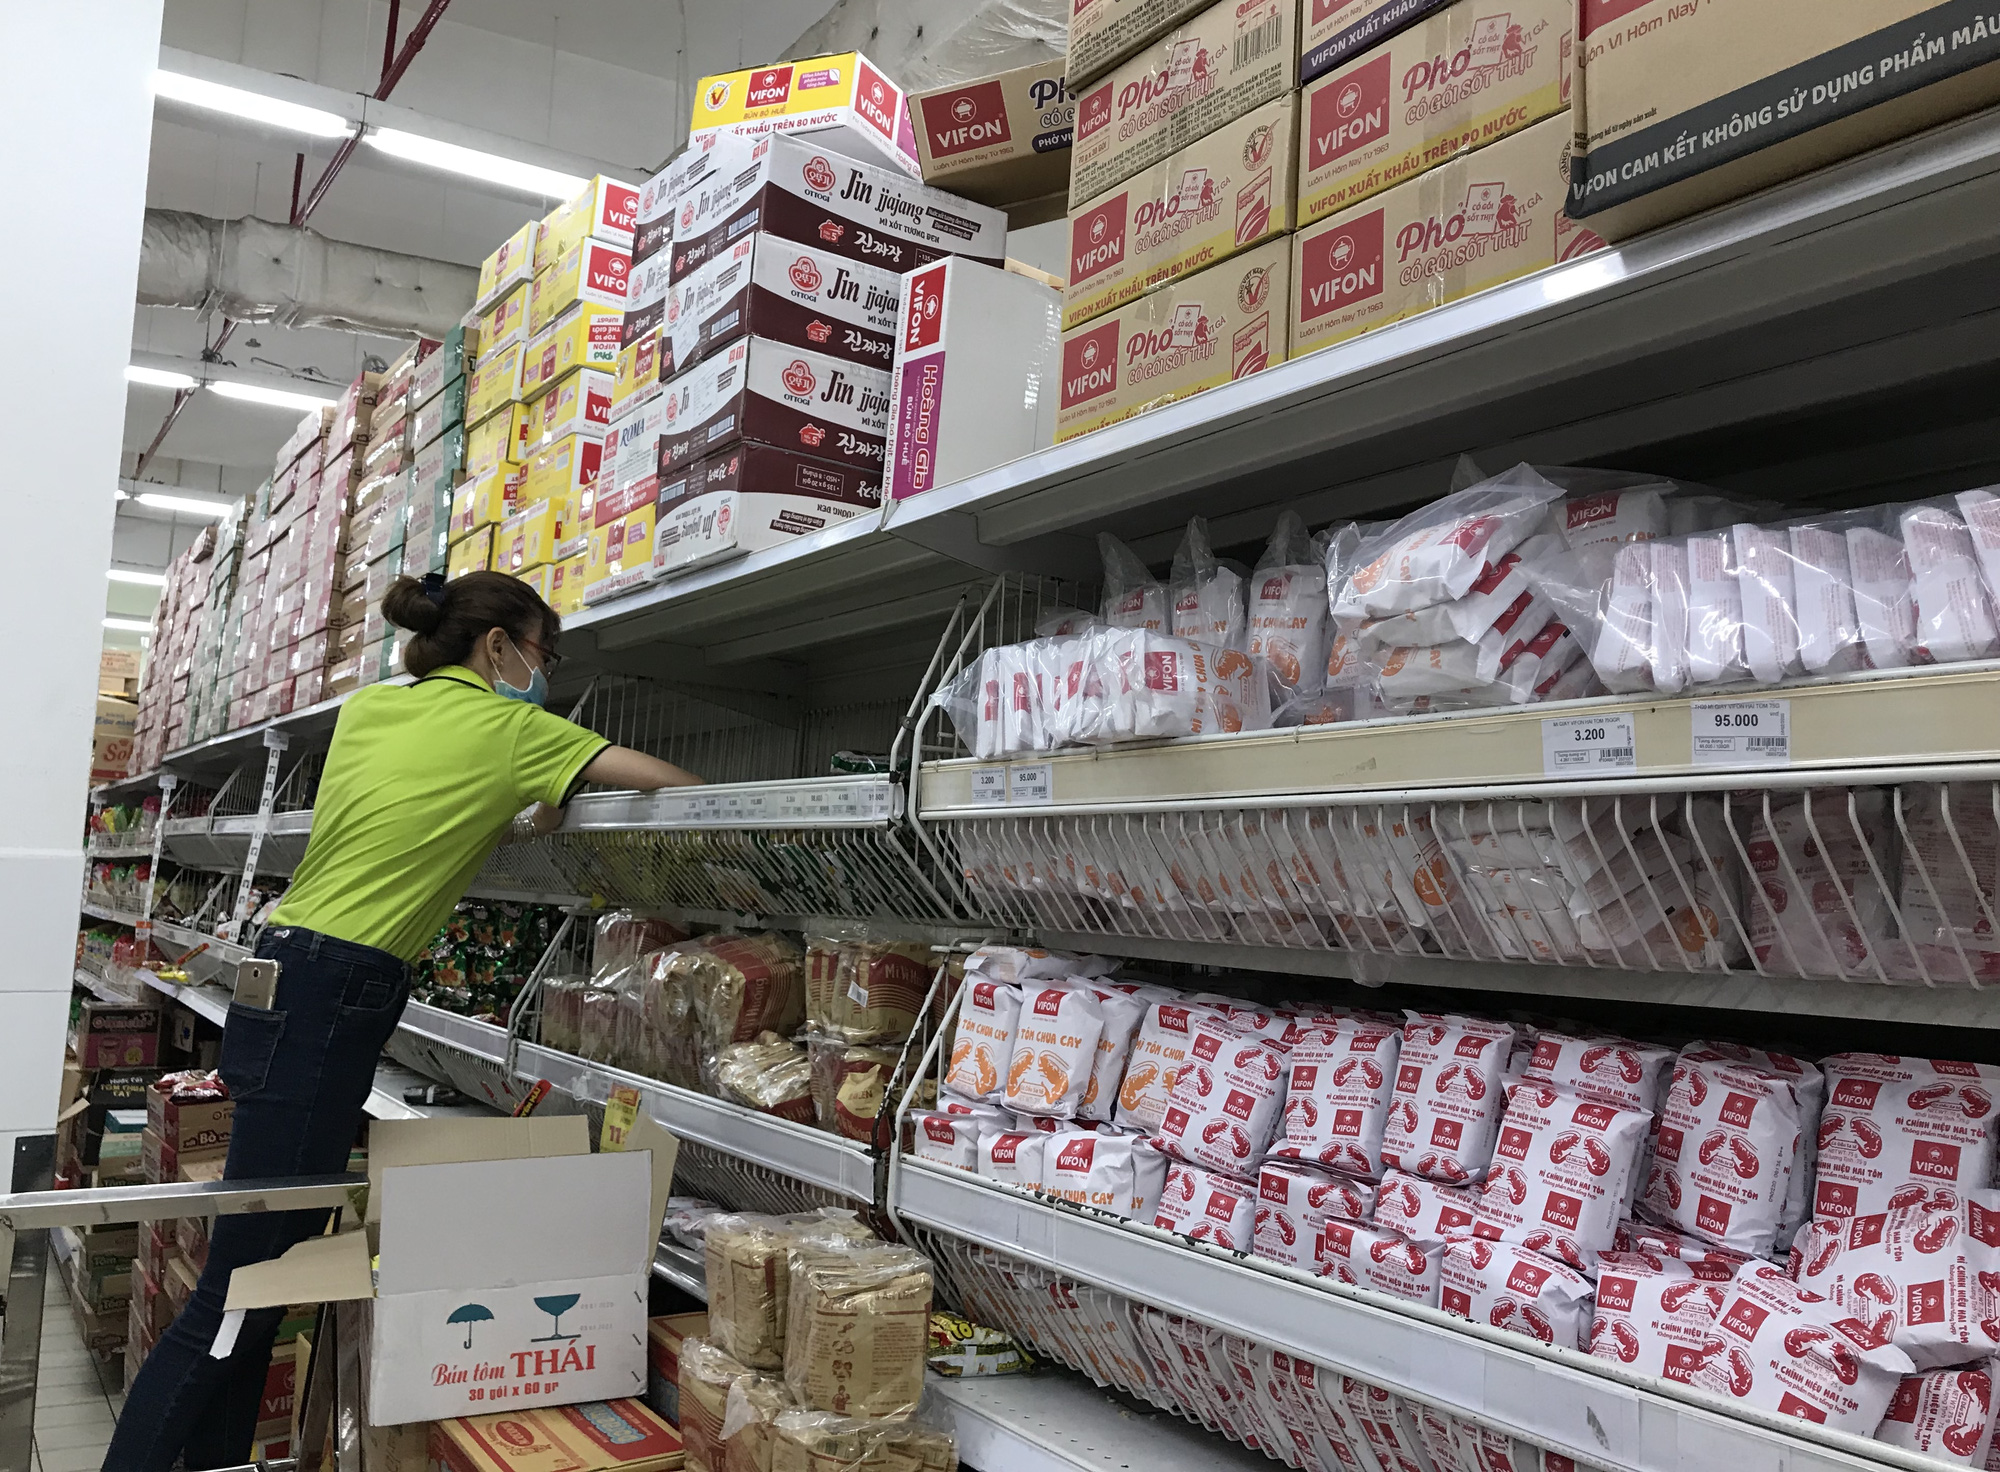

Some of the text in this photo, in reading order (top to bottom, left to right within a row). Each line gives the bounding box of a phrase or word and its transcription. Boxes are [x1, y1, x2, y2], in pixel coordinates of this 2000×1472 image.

[744, 104, 786, 120] BÚN BÒ HUẾ
[1621, 150, 1660, 182] CAM
[1663, 130, 1698, 170] KẾT
[1702, 105, 1772, 150] KHÔNG
[1776, 89, 1809, 118] SỬ
[1812, 63, 1874, 106] DỤNG
[1880, 32, 1946, 78] PHẨM
[744, 120, 770, 136] KHẨU
[772, 118, 795, 131] TRÊN
[810, 113, 838, 125] NƯỚC
[1081, 110, 1109, 134] VIFON
[936, 118, 1002, 149] VIFON
[1316, 108, 1382, 156] VIFON
[933, 160, 950, 172] Luôn
[958, 155, 974, 165] Hôm
[975, 154, 988, 164] Nay
[999, 147, 1014, 156] 1963
[1310, 191, 1346, 215] VIFON
[1348, 168, 1382, 198] XUẤT
[1384, 150, 1420, 182] KHẨU
[1423, 138, 1460, 164] TRÊN
[1482, 106, 1528, 141] NƯỚC
[804, 188, 830, 202] OTTOGI
[840, 168, 925, 225] Jin jjajang
[880, 217, 888, 226] MÌ
[889, 219, 902, 230] XỐT
[904, 226, 926, 240] TƯƠNG
[1396, 202, 1467, 263] Phở
[1076, 237, 1120, 274] VIFON
[1400, 219, 1532, 286] CÓ GÓI SỐT THỊT
[827, 268, 860, 302] Jin
[1310, 264, 1376, 308] VIFON
[790, 290, 817, 302] OTTOGI
[1300, 324, 1316, 339] Luôn
[1324, 314, 1340, 328] Hôm
[1340, 310, 1356, 324] Nay
[1368, 301, 1384, 314] 1963
[608, 326, 621, 334] THẾ
[842, 330, 894, 360] 진짜장
[1127, 337, 1219, 386] CÓ GÓI SỐT THỊT
[820, 370, 855, 406] Jin
[1066, 364, 1112, 398] VIFON
[784, 393, 810, 406] OTTOGI
[620, 418, 645, 447] ROMA
[914, 364, 938, 488] Hoàng Gia
[1714, 714, 1759, 727] 95.000
[1574, 728, 1605, 741] 3.200
[980, 776, 994, 784] 3.200
[1020, 772, 1037, 782] 95.000
[974, 993, 993, 1008] VIFON
[1036, 1000, 1058, 1013] VIFON
[1160, 1014, 1186, 1028] VIFON
[1020, 1027, 1082, 1050] TÔM CHUA CAY
[1458, 1044, 1480, 1056] VIFON
[1838, 1092, 1872, 1106] VIFON
[1226, 1103, 1249, 1118] VIFON
[1722, 1110, 1748, 1124] VIFON
[1335, 1124, 1358, 1134] VIFON
[1576, 1114, 1607, 1127] VIFON
[200, 1131, 216, 1144] Bò
[926, 1128, 954, 1142] VIFON
[1434, 1134, 1457, 1148] VIFON
[1902, 1128, 1979, 1146] Không phẩm màu tổng hợp
[994, 1148, 1014, 1160] VIFON
[1500, 1144, 1524, 1157] VIFON
[1060, 1154, 1088, 1168] VIFON
[1916, 1160, 1954, 1176] VIFON
[1546, 1172, 1564, 1182] CHÍNH
[1564, 1174, 1578, 1187] HIỆU
[1578, 1181, 1591, 1190] HAI
[1592, 1184, 1606, 1196] TÔM
[1262, 1188, 1286, 1200] VIFON
[1820, 1201, 1852, 1216] VIFON
[1547, 1210, 1575, 1226] VIFON
[1700, 1214, 1724, 1232] VIFON
[1852, 1218, 1866, 1246] VIFON
[1327, 1239, 1348, 1254] VIFON
[1512, 1277, 1540, 1294] VIFON
[1600, 1294, 1630, 1308] VIFON
[1911, 1288, 1923, 1322] VIFON
[1651, 1320, 1702, 1337] MÌ CHÍNH HIỆU
[1726, 1316, 1755, 1337] VIFON
[432, 1339, 597, 1387] Bún tôm THÁI
[468, 1381, 559, 1401] 30 gói x 60 gr
[1770, 1360, 1860, 1411] MÌ CHÍNH HIỆU HAI TÔM
[1774, 1372, 1848, 1416] Không phẩm màu tổng hợp
